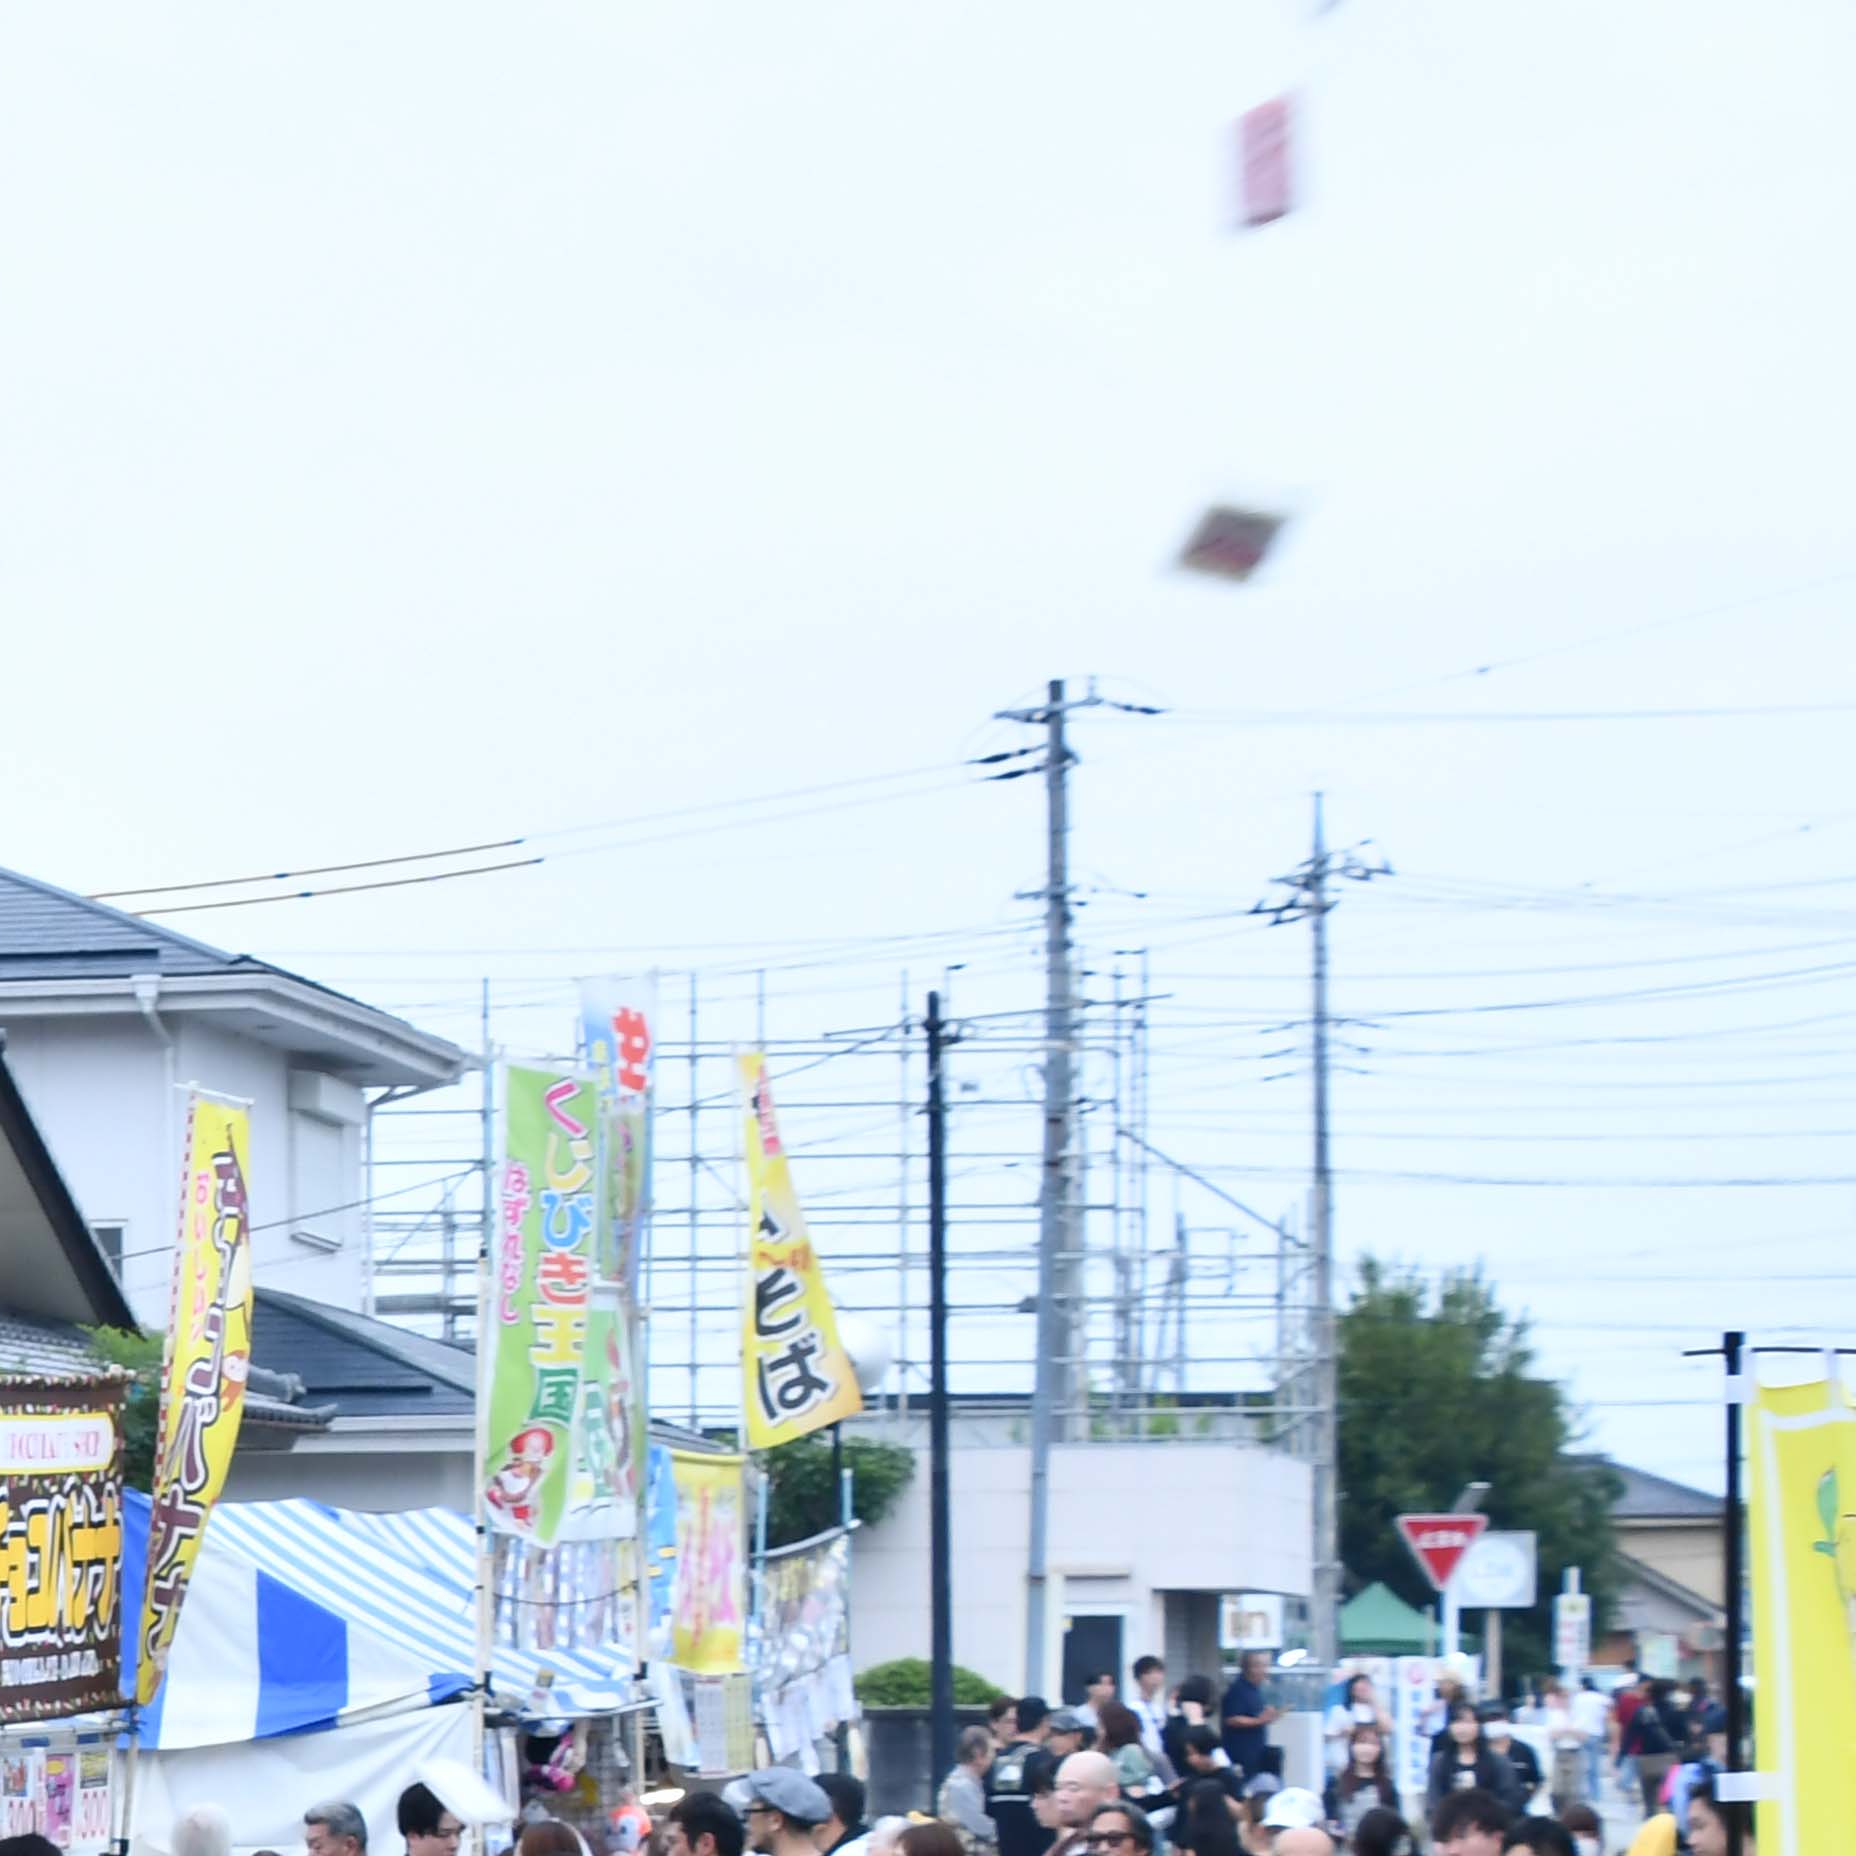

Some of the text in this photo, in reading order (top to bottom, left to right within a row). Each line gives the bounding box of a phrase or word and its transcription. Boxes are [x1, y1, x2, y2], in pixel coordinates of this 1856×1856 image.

[529, 1077, 594, 1425] くじびき王国
